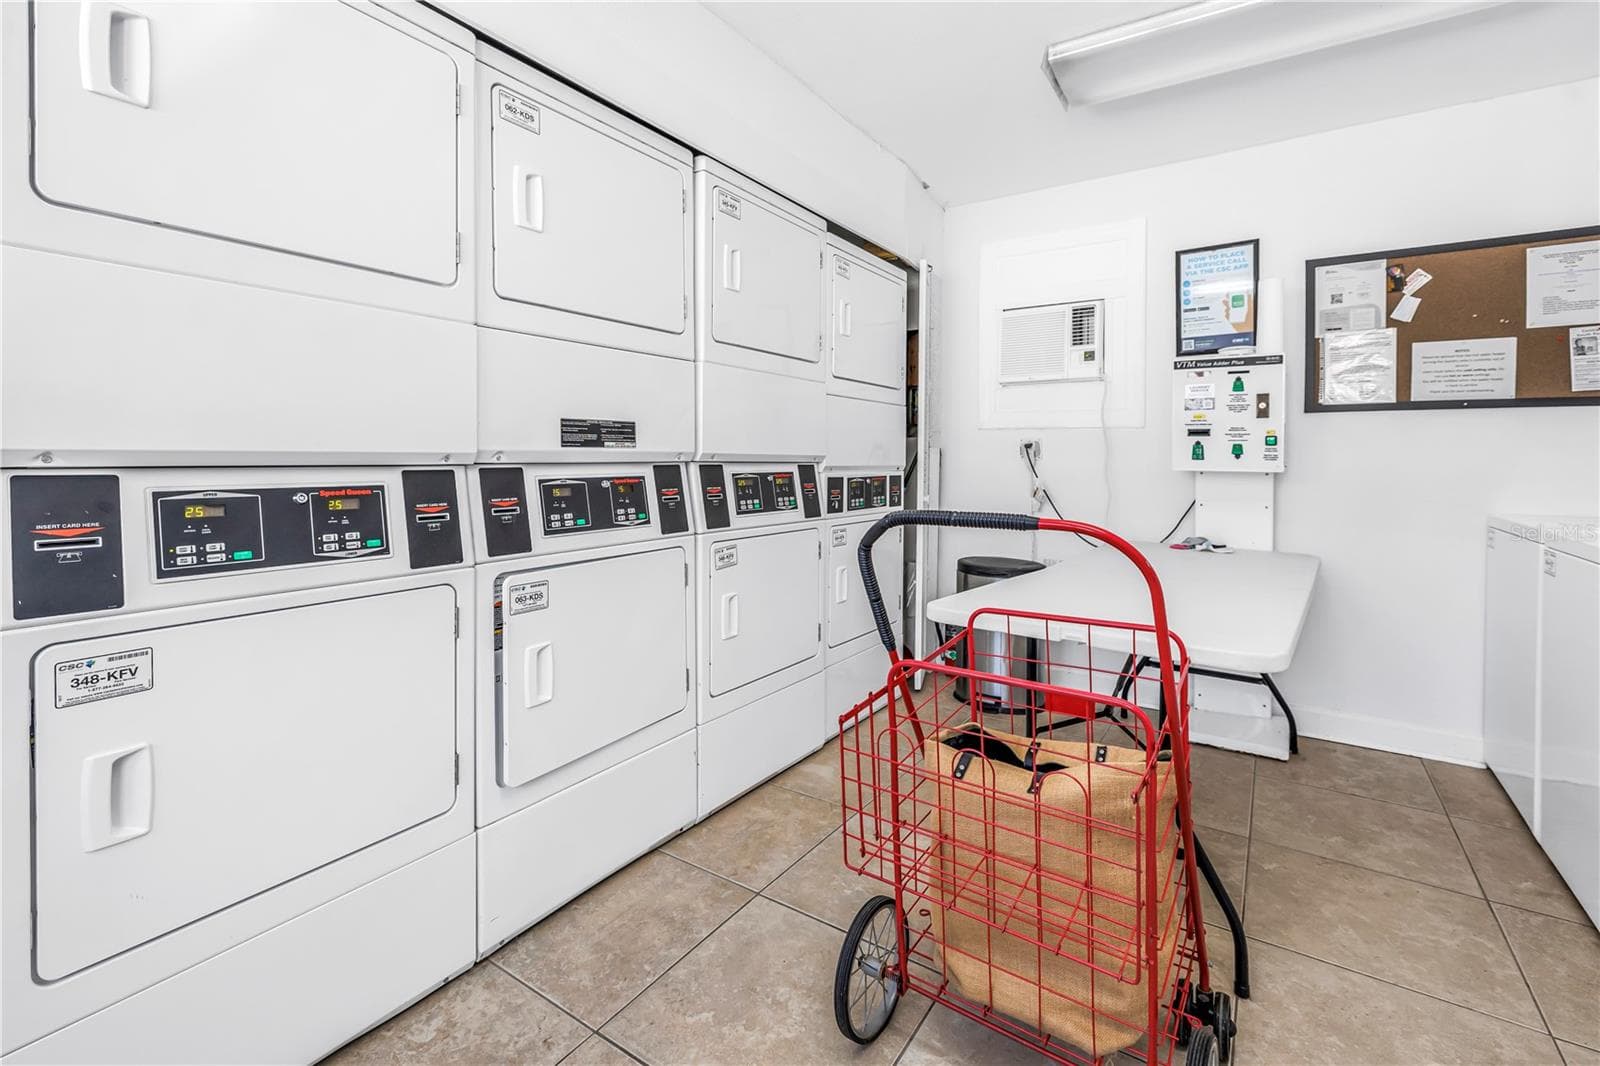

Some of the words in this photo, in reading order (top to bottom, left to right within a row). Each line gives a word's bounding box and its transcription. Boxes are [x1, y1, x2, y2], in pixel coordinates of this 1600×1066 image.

[1220, 250, 1245, 258] PLACE
[1194, 260, 1226, 269] SERVICE
[1176, 361, 1196, 369] VTM
[319, 489, 346, 497] Speed
[328, 500, 342, 510] 25
[184, 506, 204, 518] 25
[514, 591, 544, 604] 063-KDS
[58, 662, 85, 672] CSC
[70, 666, 139, 688] 348-KFV
